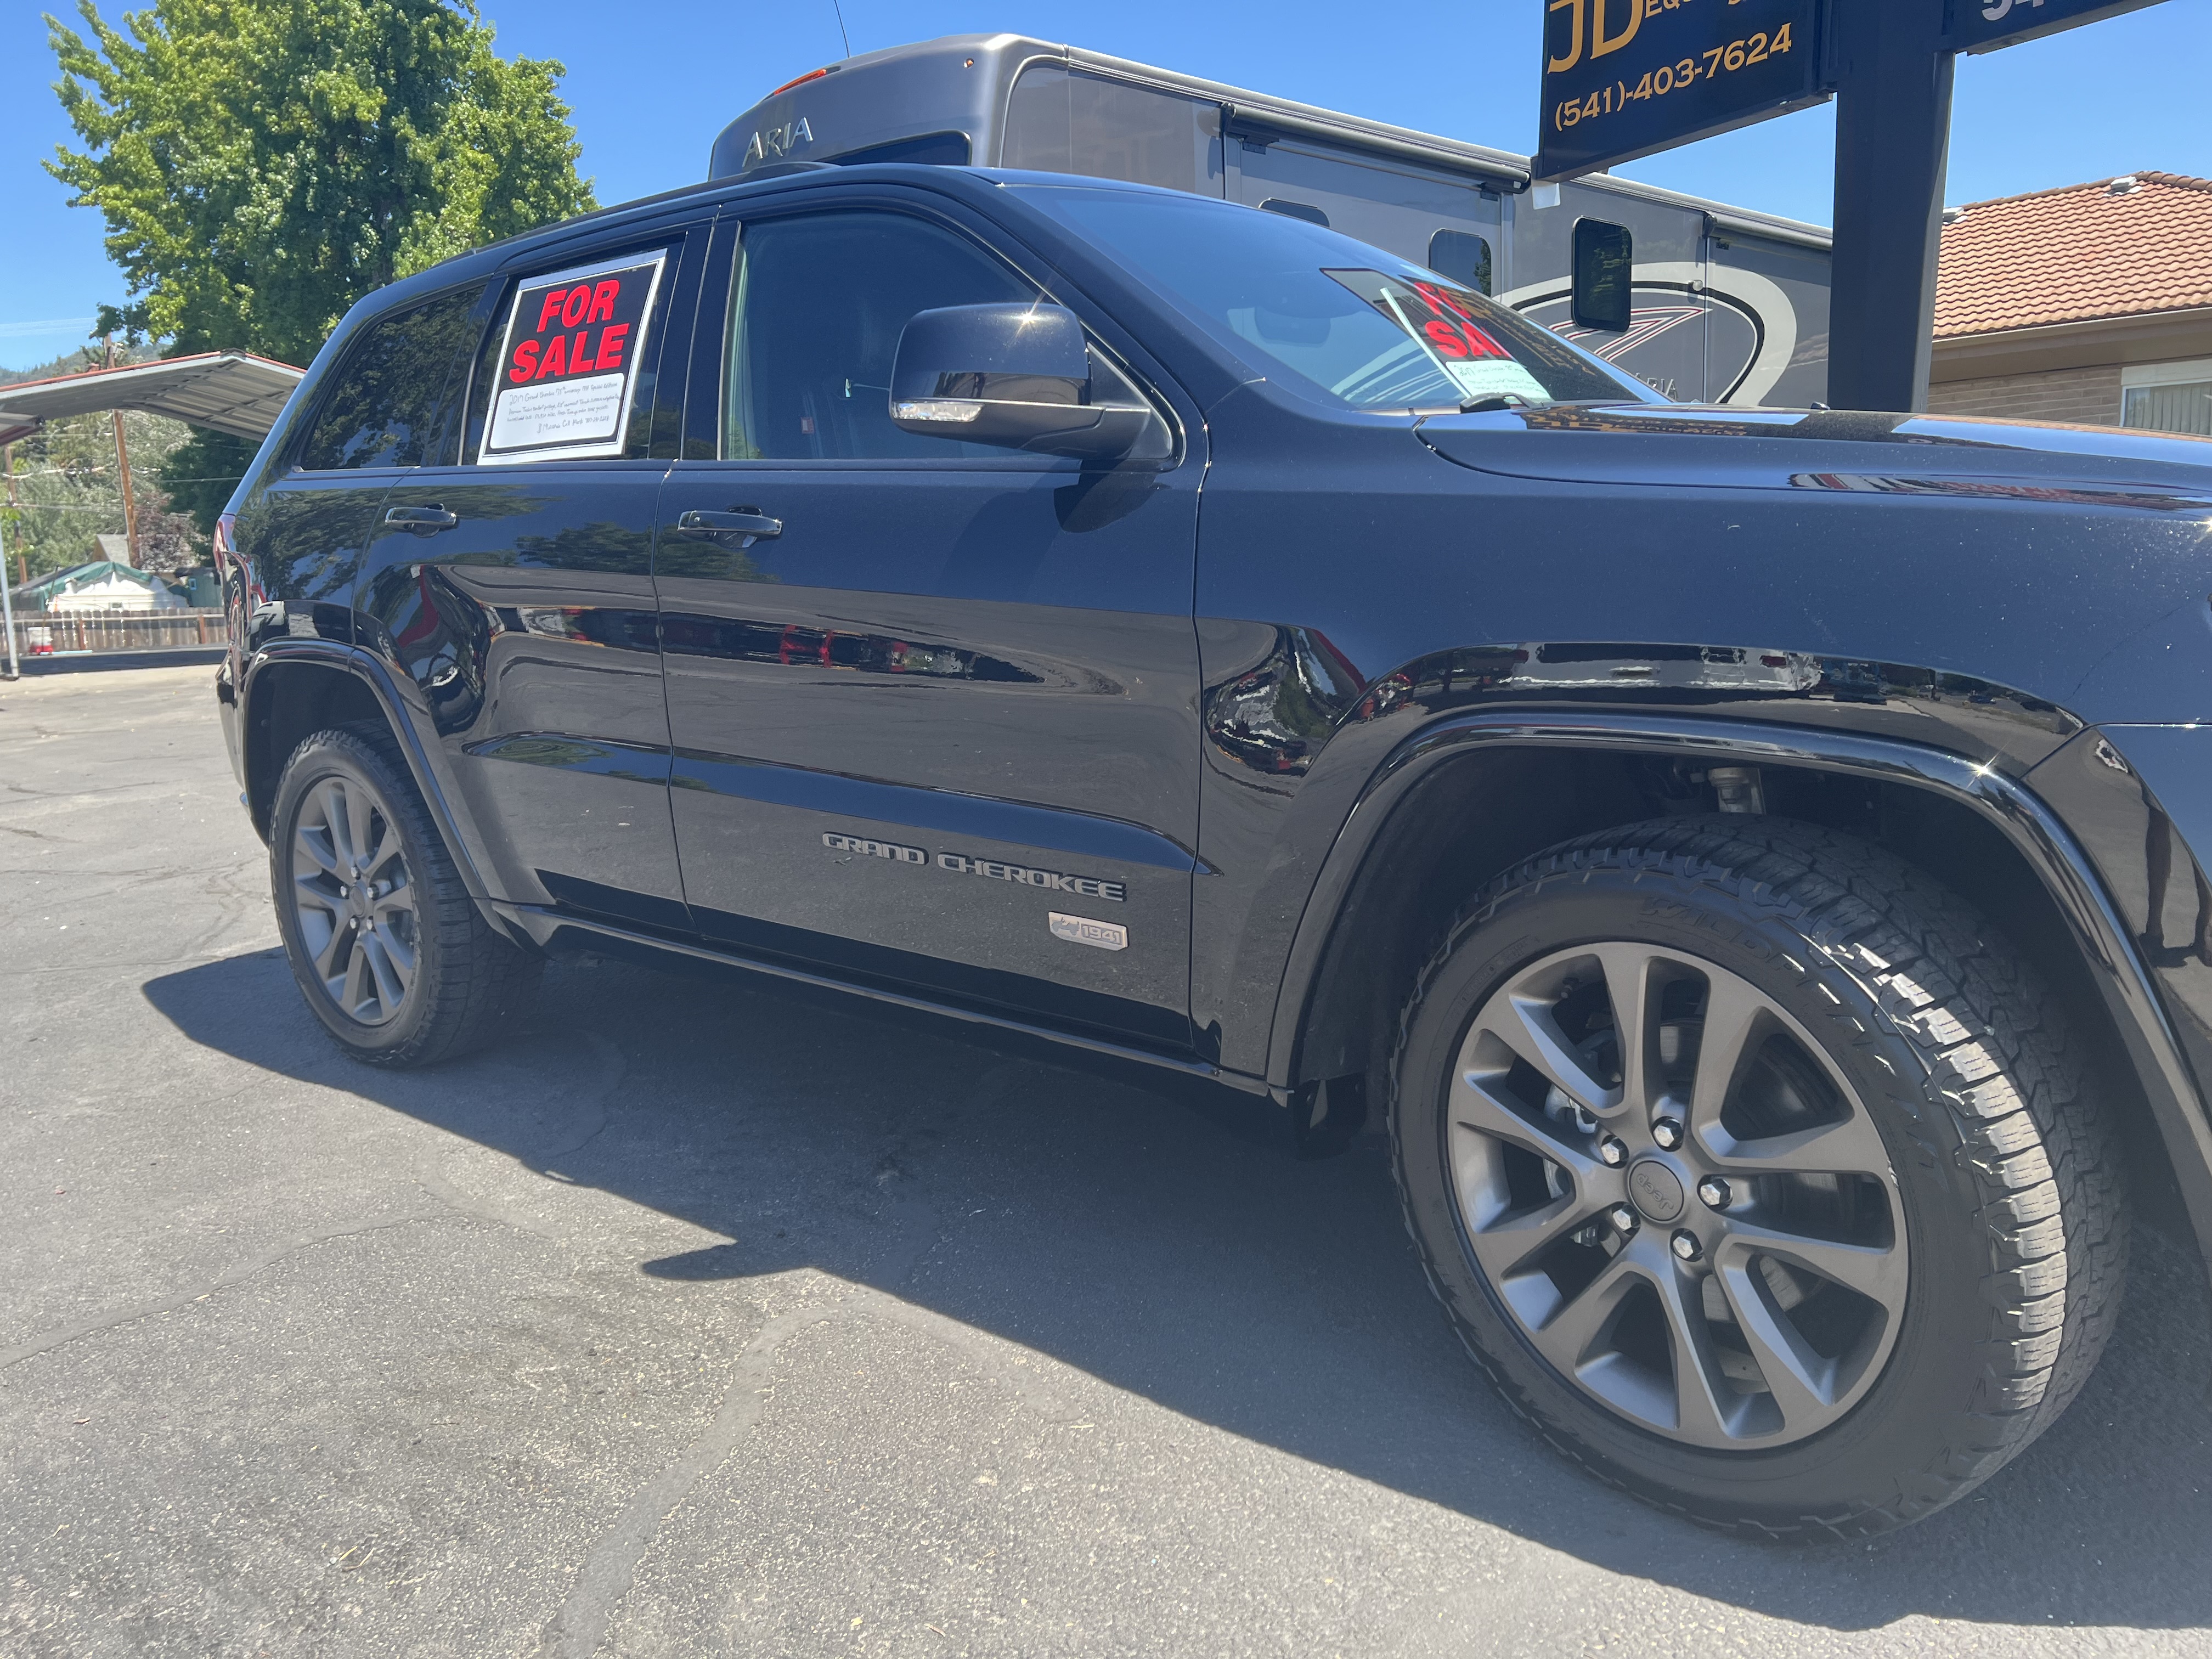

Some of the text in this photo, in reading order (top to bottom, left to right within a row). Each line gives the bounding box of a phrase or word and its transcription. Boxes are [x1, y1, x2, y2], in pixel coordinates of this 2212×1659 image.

[1547, 0, 1644, 74] JD
[1555, 22, 1792, 132] (541)-403-7624
[742, 117, 813, 167] ARIA
[536, 279, 620, 333] FOR
[509, 323, 630, 383] SALE
[509, 394, 524, 406] 2017
[562, 419, 571, 427] Call
[822, 831, 1127, 902] GRAND CHEROKEE
[1081, 924, 1122, 945] 1941
[1636, 1173, 1674, 1210] Jeep
